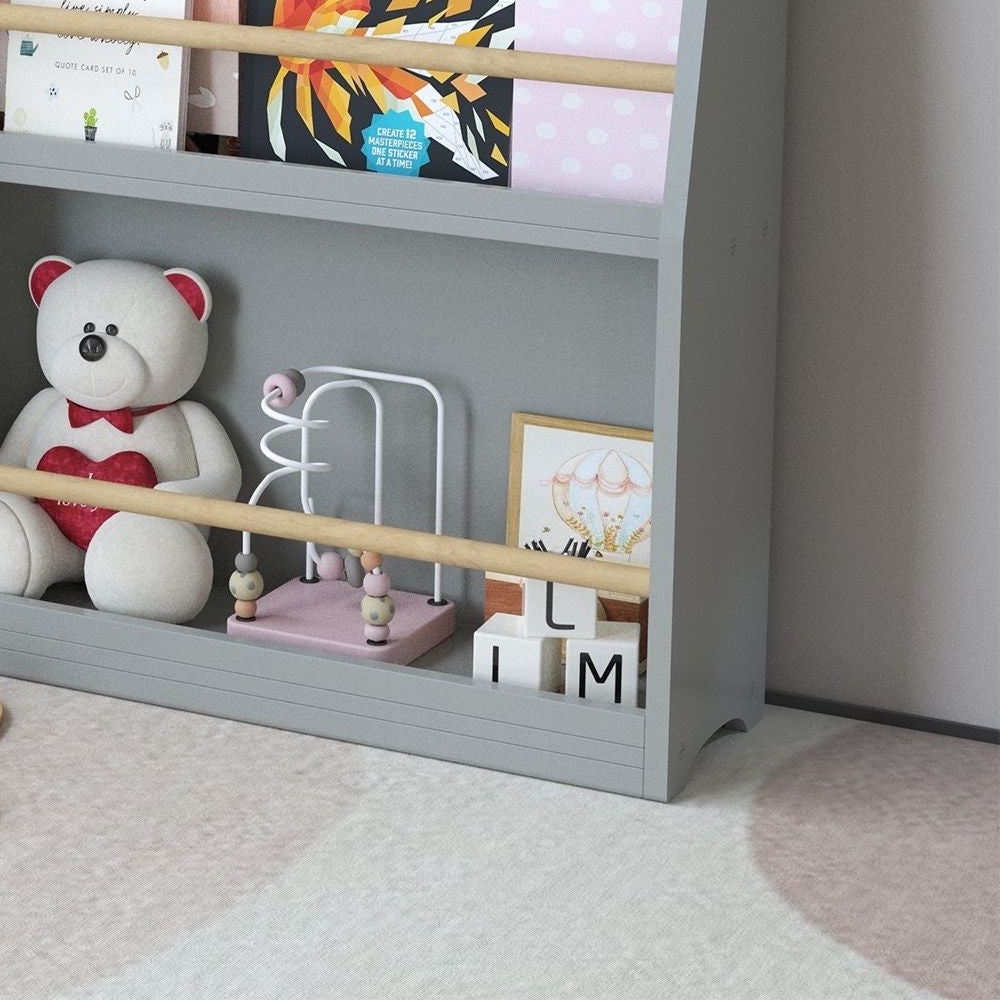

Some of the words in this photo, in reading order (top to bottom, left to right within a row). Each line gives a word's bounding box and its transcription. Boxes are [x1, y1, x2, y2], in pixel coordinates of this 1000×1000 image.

[54, 61, 78, 71] QUOTE
[80, 63, 99, 73] CARD
[102, 65, 113, 74] SET
[116, 67, 125, 75] OF
[128, 69, 137, 77] 10
[377, 128, 405, 138] CREATE
[406, 129, 417, 139] 12
[368, 136, 423, 150] MASTERPIECES
[371, 147, 387, 157] ONE
[388, 148, 418, 160] STICKER
[376, 158, 386, 166] AT
[386, 158, 392, 167] A
[393, 159, 413, 169] TIME!
[546, 580, 575, 630] L
[578, 652, 622, 704] M
